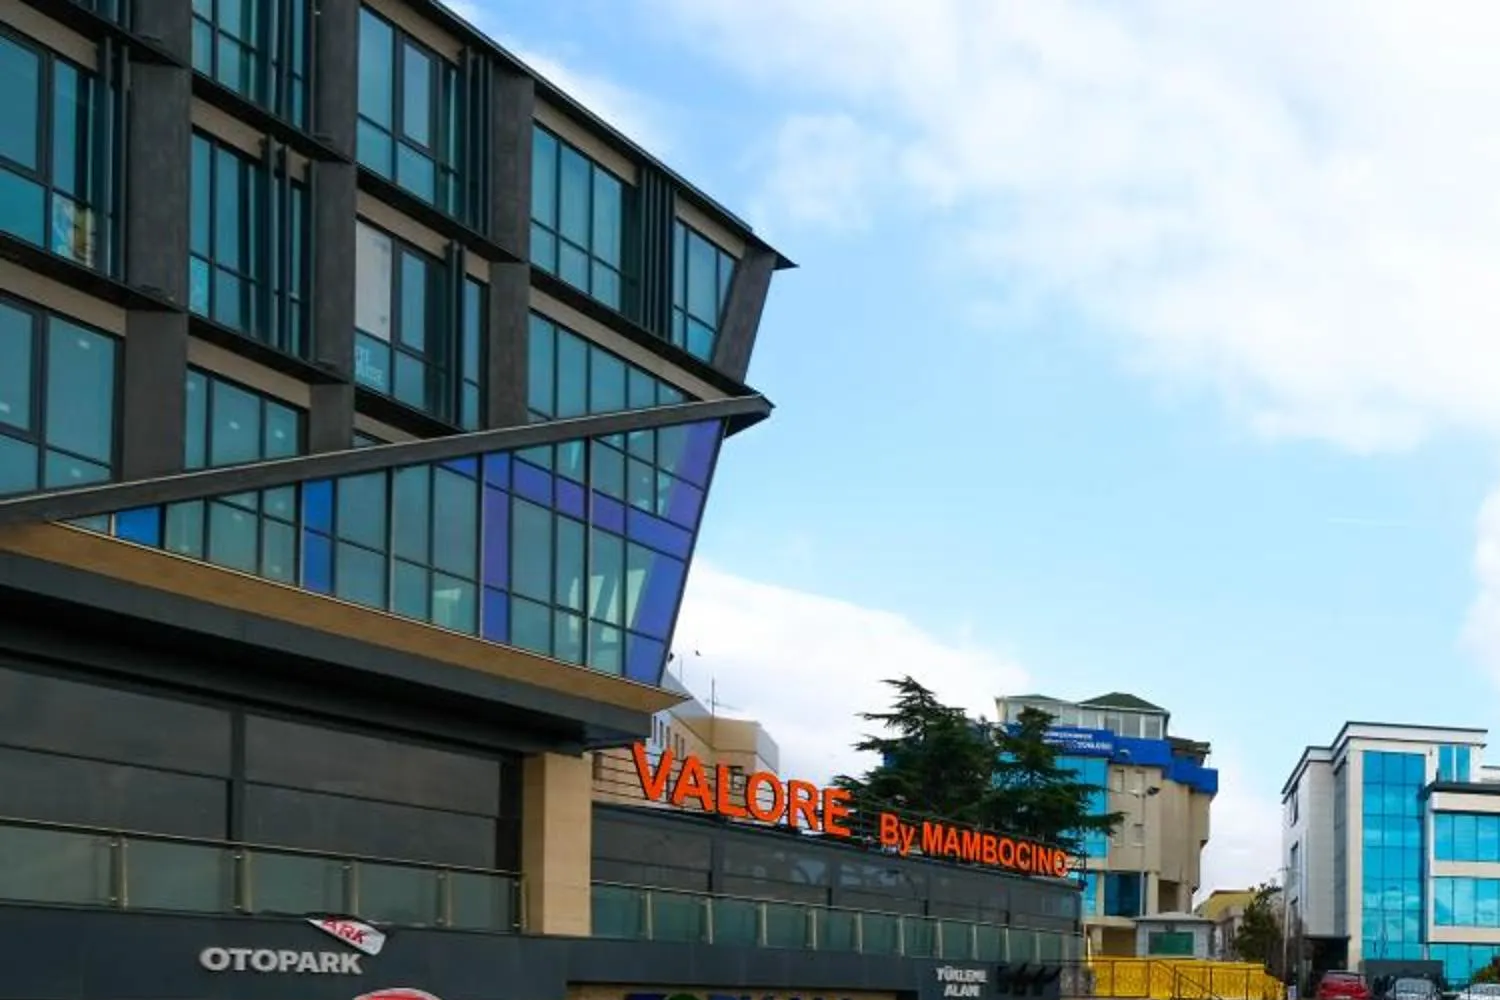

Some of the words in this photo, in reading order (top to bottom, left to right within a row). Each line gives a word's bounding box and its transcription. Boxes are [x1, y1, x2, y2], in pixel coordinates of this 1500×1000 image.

[632, 741, 856, 837] VALORE
[879, 811, 916, 857] By
[922, 820, 1068, 877] MAMBOCINO
[200, 947, 363, 975] OTOPARK
